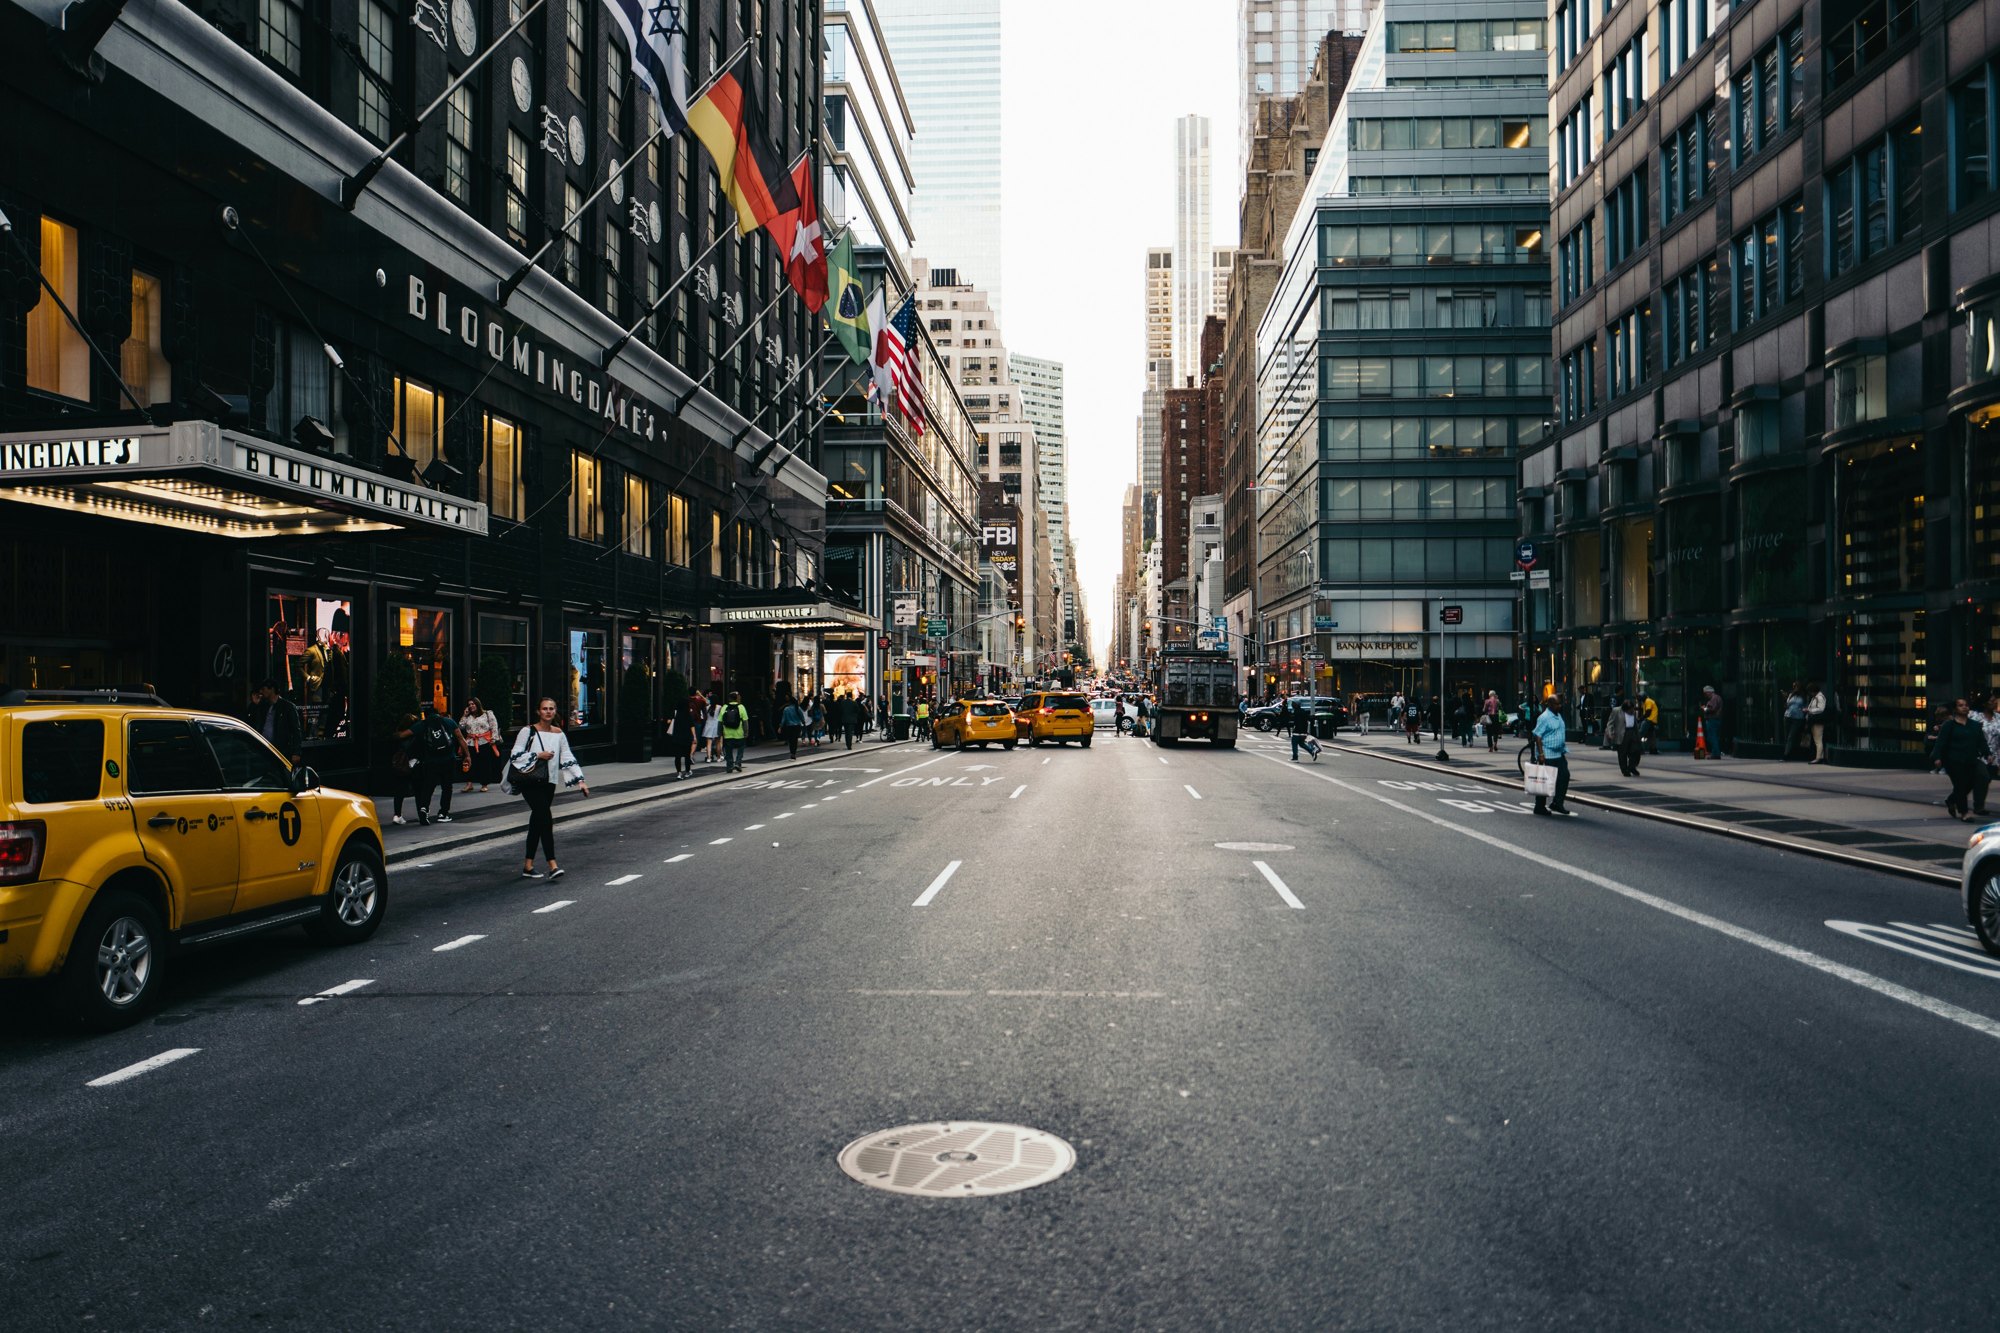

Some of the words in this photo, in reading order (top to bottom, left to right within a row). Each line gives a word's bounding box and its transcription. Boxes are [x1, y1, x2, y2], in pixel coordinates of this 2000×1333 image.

[408, 274, 655, 442] BLOOMINGDALE'S
[983, 526, 1017, 545] FBI
[1336, 642, 1373, 650] BANANA
[1374, 642, 1418, 650] REPUBLIC
[889, 776, 1006, 787] ONLY
[1377, 780, 1502, 794] ONLY
